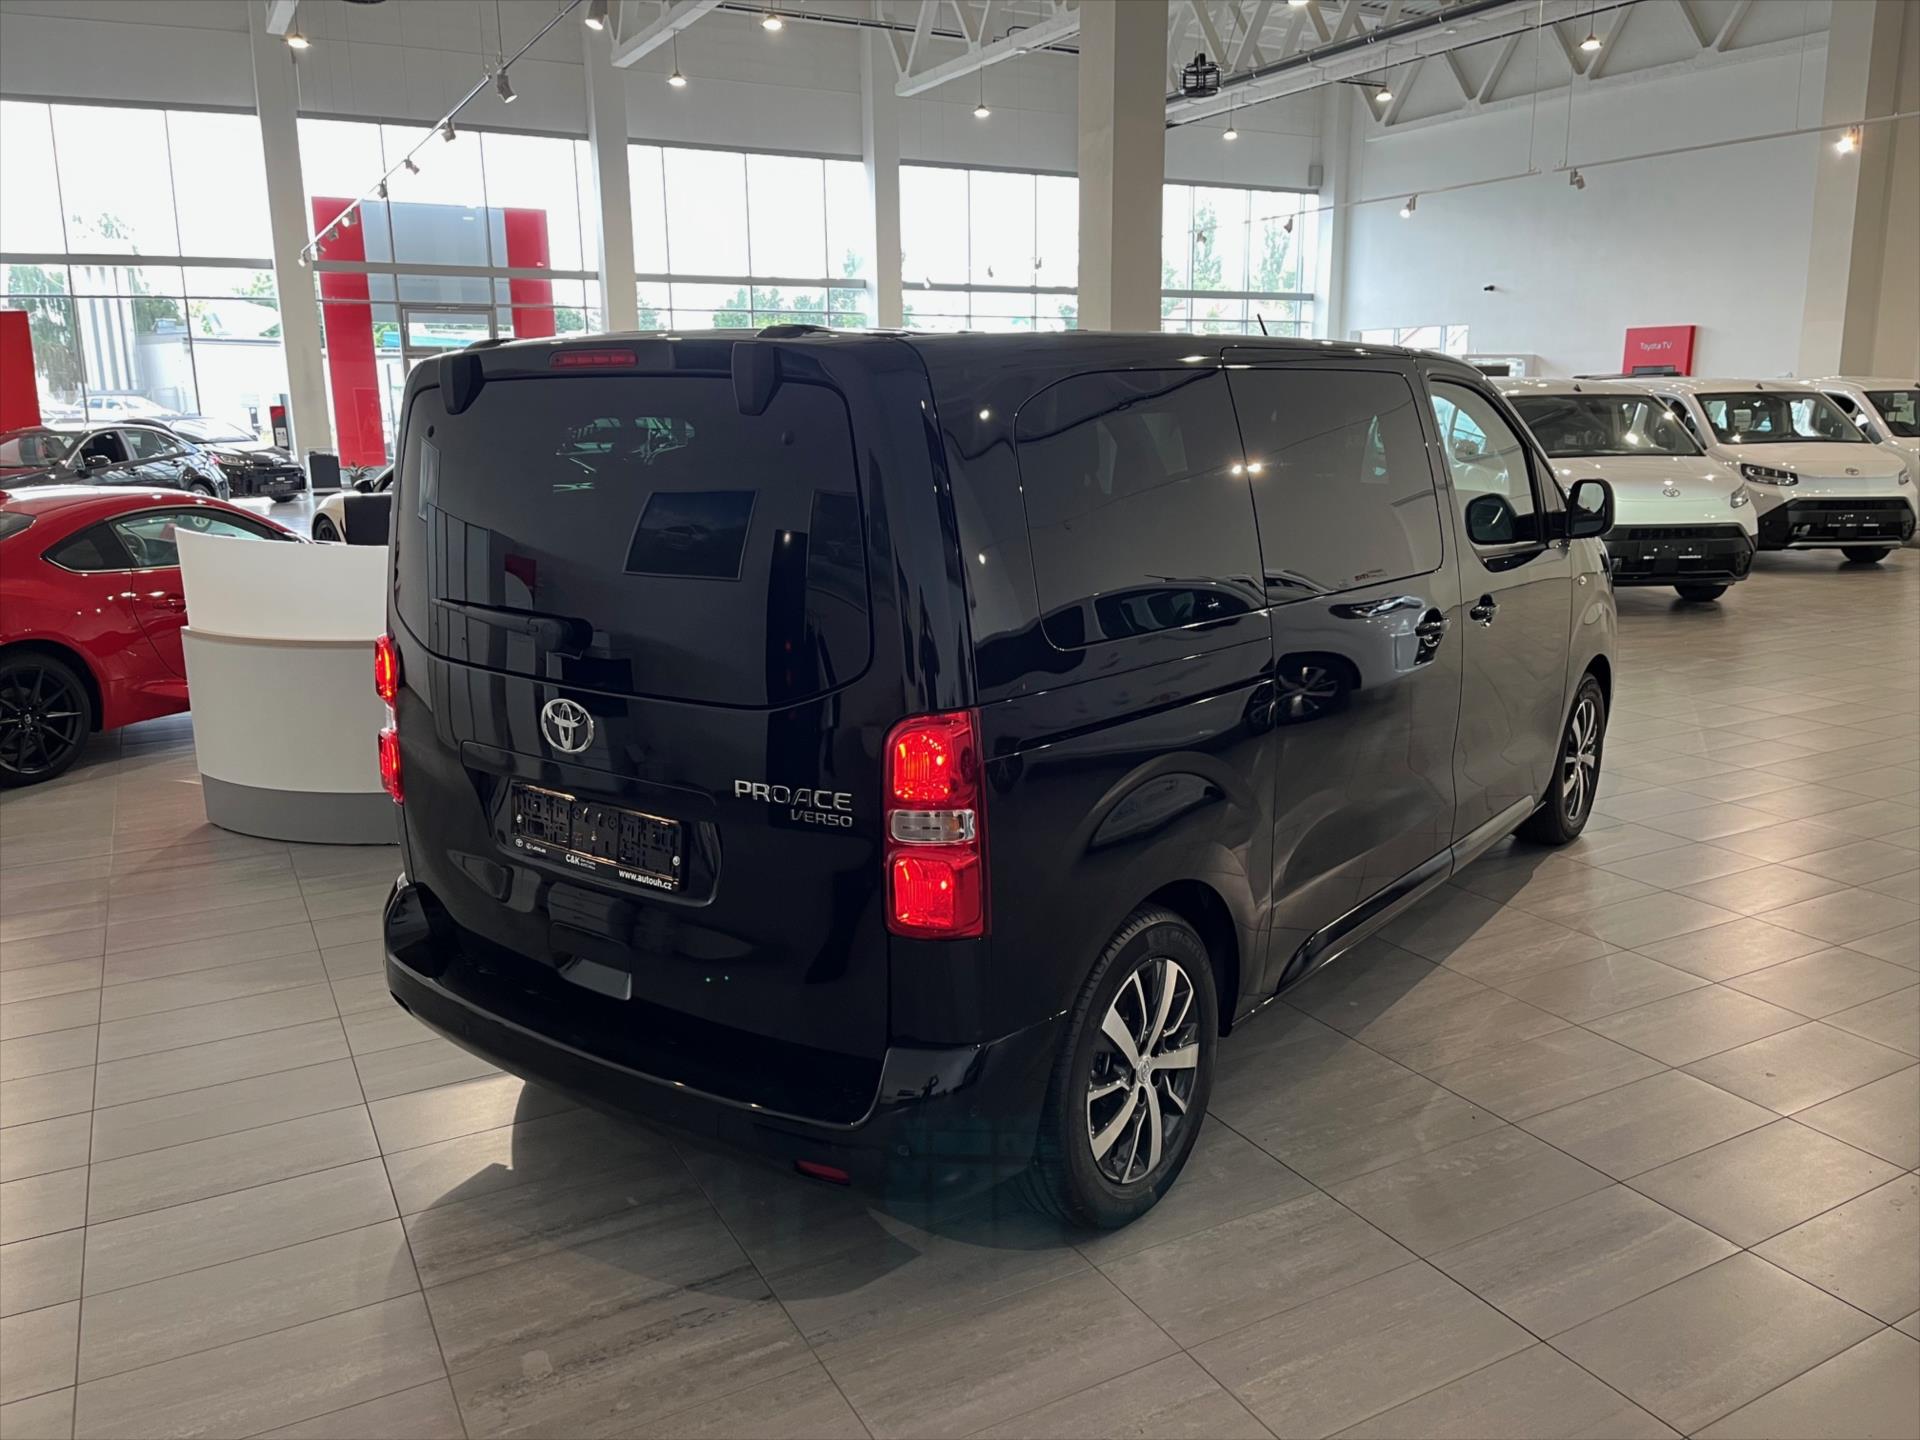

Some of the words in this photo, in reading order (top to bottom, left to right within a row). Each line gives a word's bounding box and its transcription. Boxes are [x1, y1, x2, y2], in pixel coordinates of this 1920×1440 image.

[1640, 342, 1661, 351] Toyota
[1662, 341, 1672, 349] TV
[734, 779, 852, 811] PROACE
[790, 808, 853, 828] VERSO
[565, 853, 580, 866] C&K
[618, 869, 672, 890] www.autouh.cz
